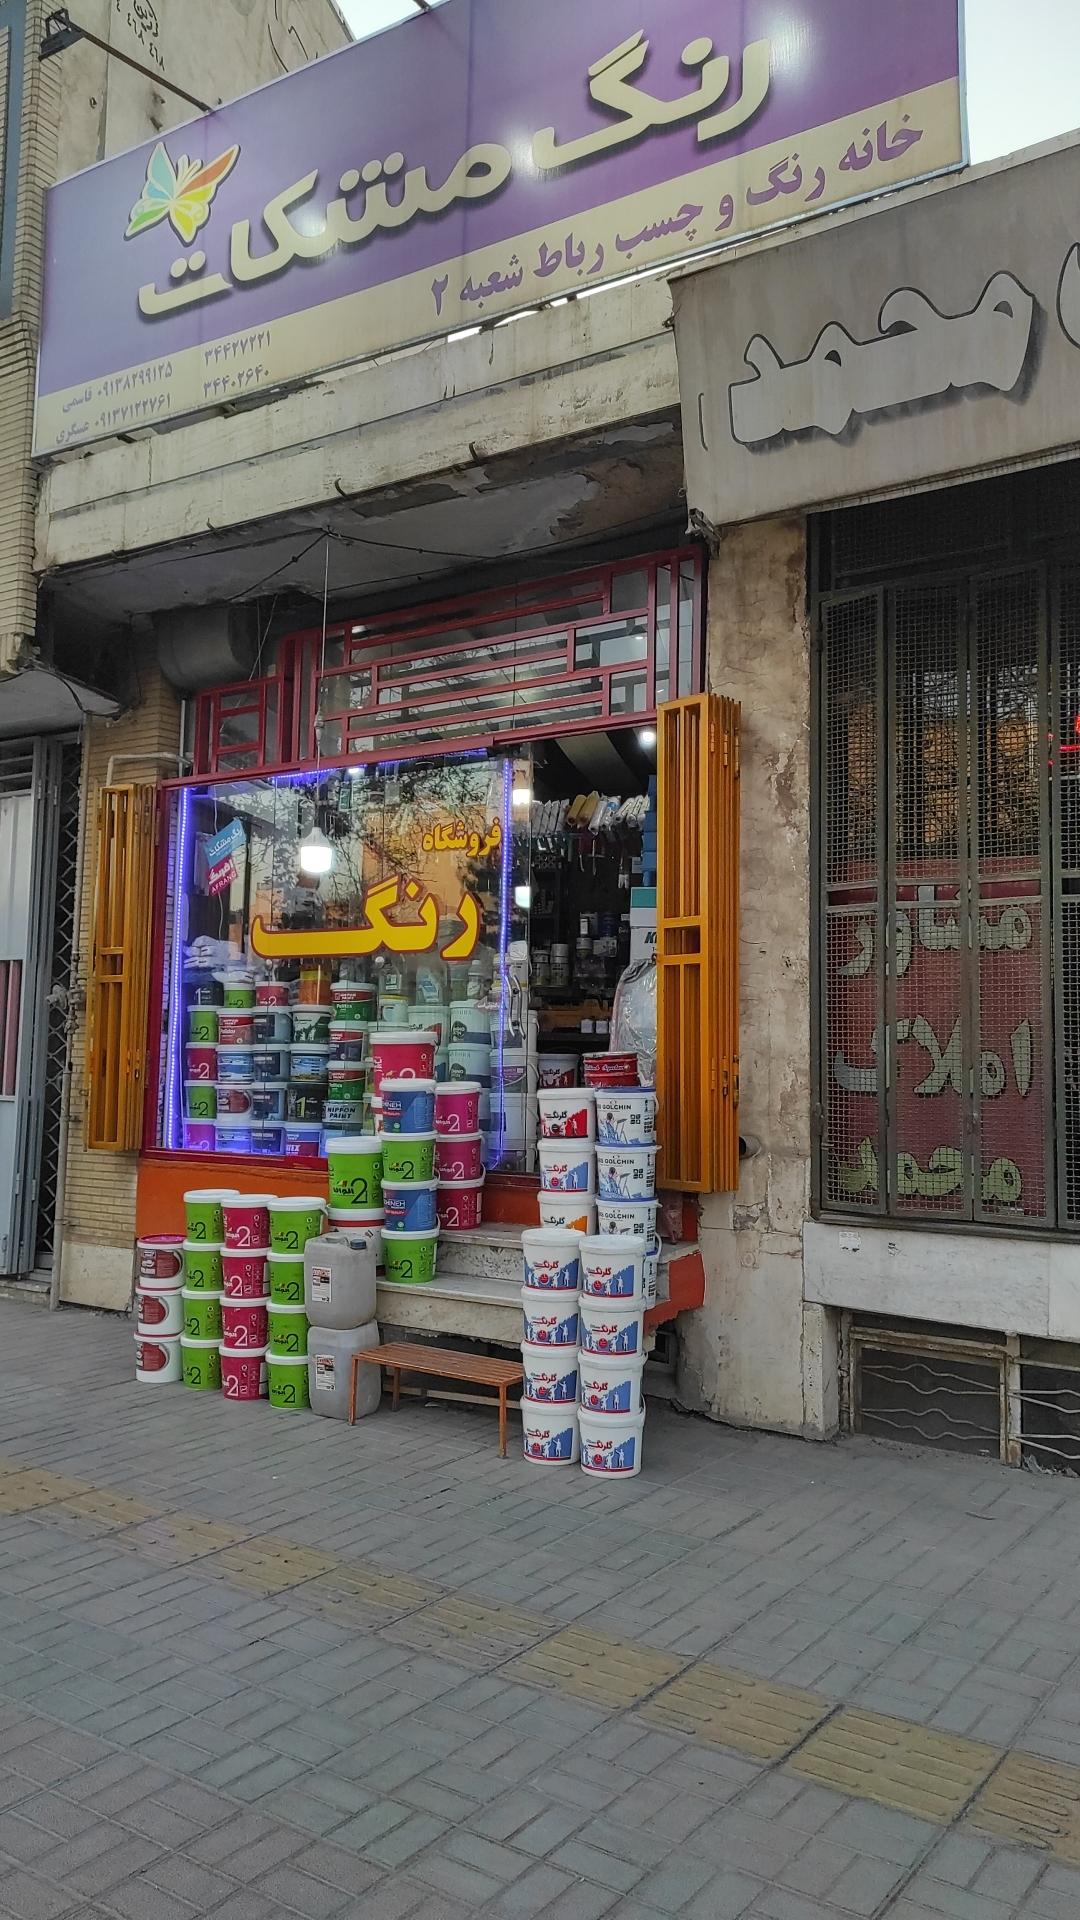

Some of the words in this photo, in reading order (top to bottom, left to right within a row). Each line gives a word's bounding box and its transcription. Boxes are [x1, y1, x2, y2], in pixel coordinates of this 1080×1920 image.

[531, 28, 771, 170] رنگ
[837, 114, 925, 174] خانه
[746, 152, 827, 205] رنگ
[714, 193, 736, 231] و
[138, 143, 513, 316] مشکات
[615, 198, 704, 260] چسب
[533, 233, 605, 279] رباط
[459, 254, 524, 309] شعبه
[431, 273, 450, 318] ۲
[728, 271, 1040, 449] محمد
[422, 816, 502, 857] فروشگاه
[211, 871, 237, 893] AFRANG
[250, 874, 486, 961] رنگ
[831, 1013, 1034, 1099] املاک
[199, 1063, 210, 1079] 2
[447, 1114, 460, 1131] 2
[401, 1161, 414, 1179] 2
[452, 1162, 465, 1179] 2
[351, 1178, 368, 1204] 2
[446, 1207, 459, 1227] 2
[195, 1222, 206, 1239] 2
[236, 1226, 250, 1246] 2
[287, 1231, 298, 1249] 2
[194, 1270, 204, 1287] 2
[401, 1259, 413, 1278] 2
[231, 1275, 242, 1296] 2
[287, 1282, 299, 1300] 2
[190, 1318, 200, 1335] 2
[234, 1325, 247, 1346] 2
[287, 1333, 299, 1352] 2
[191, 1366, 201, 1384] 2
[227, 1375, 239, 1396] 2
[283, 1384, 295, 1403] 2
